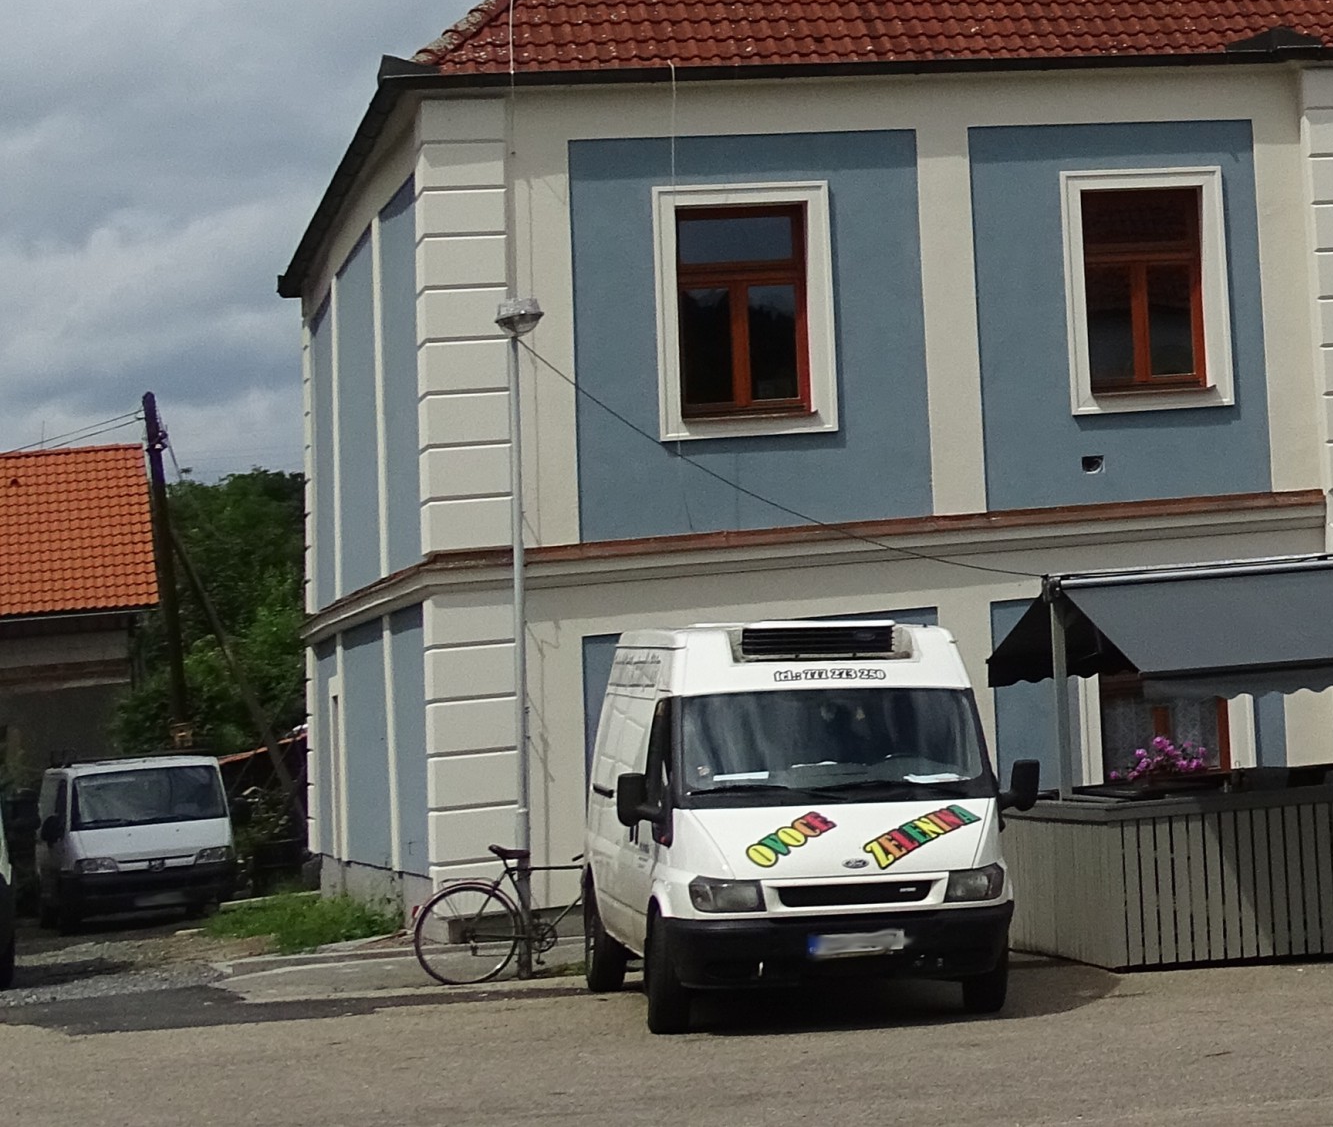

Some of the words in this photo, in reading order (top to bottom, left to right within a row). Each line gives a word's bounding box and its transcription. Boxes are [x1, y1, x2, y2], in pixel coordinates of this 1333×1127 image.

[858, 669, 886, 681] 250
[746, 811, 838, 868] OVOCE
[863, 804, 982, 870] ZELENINA
